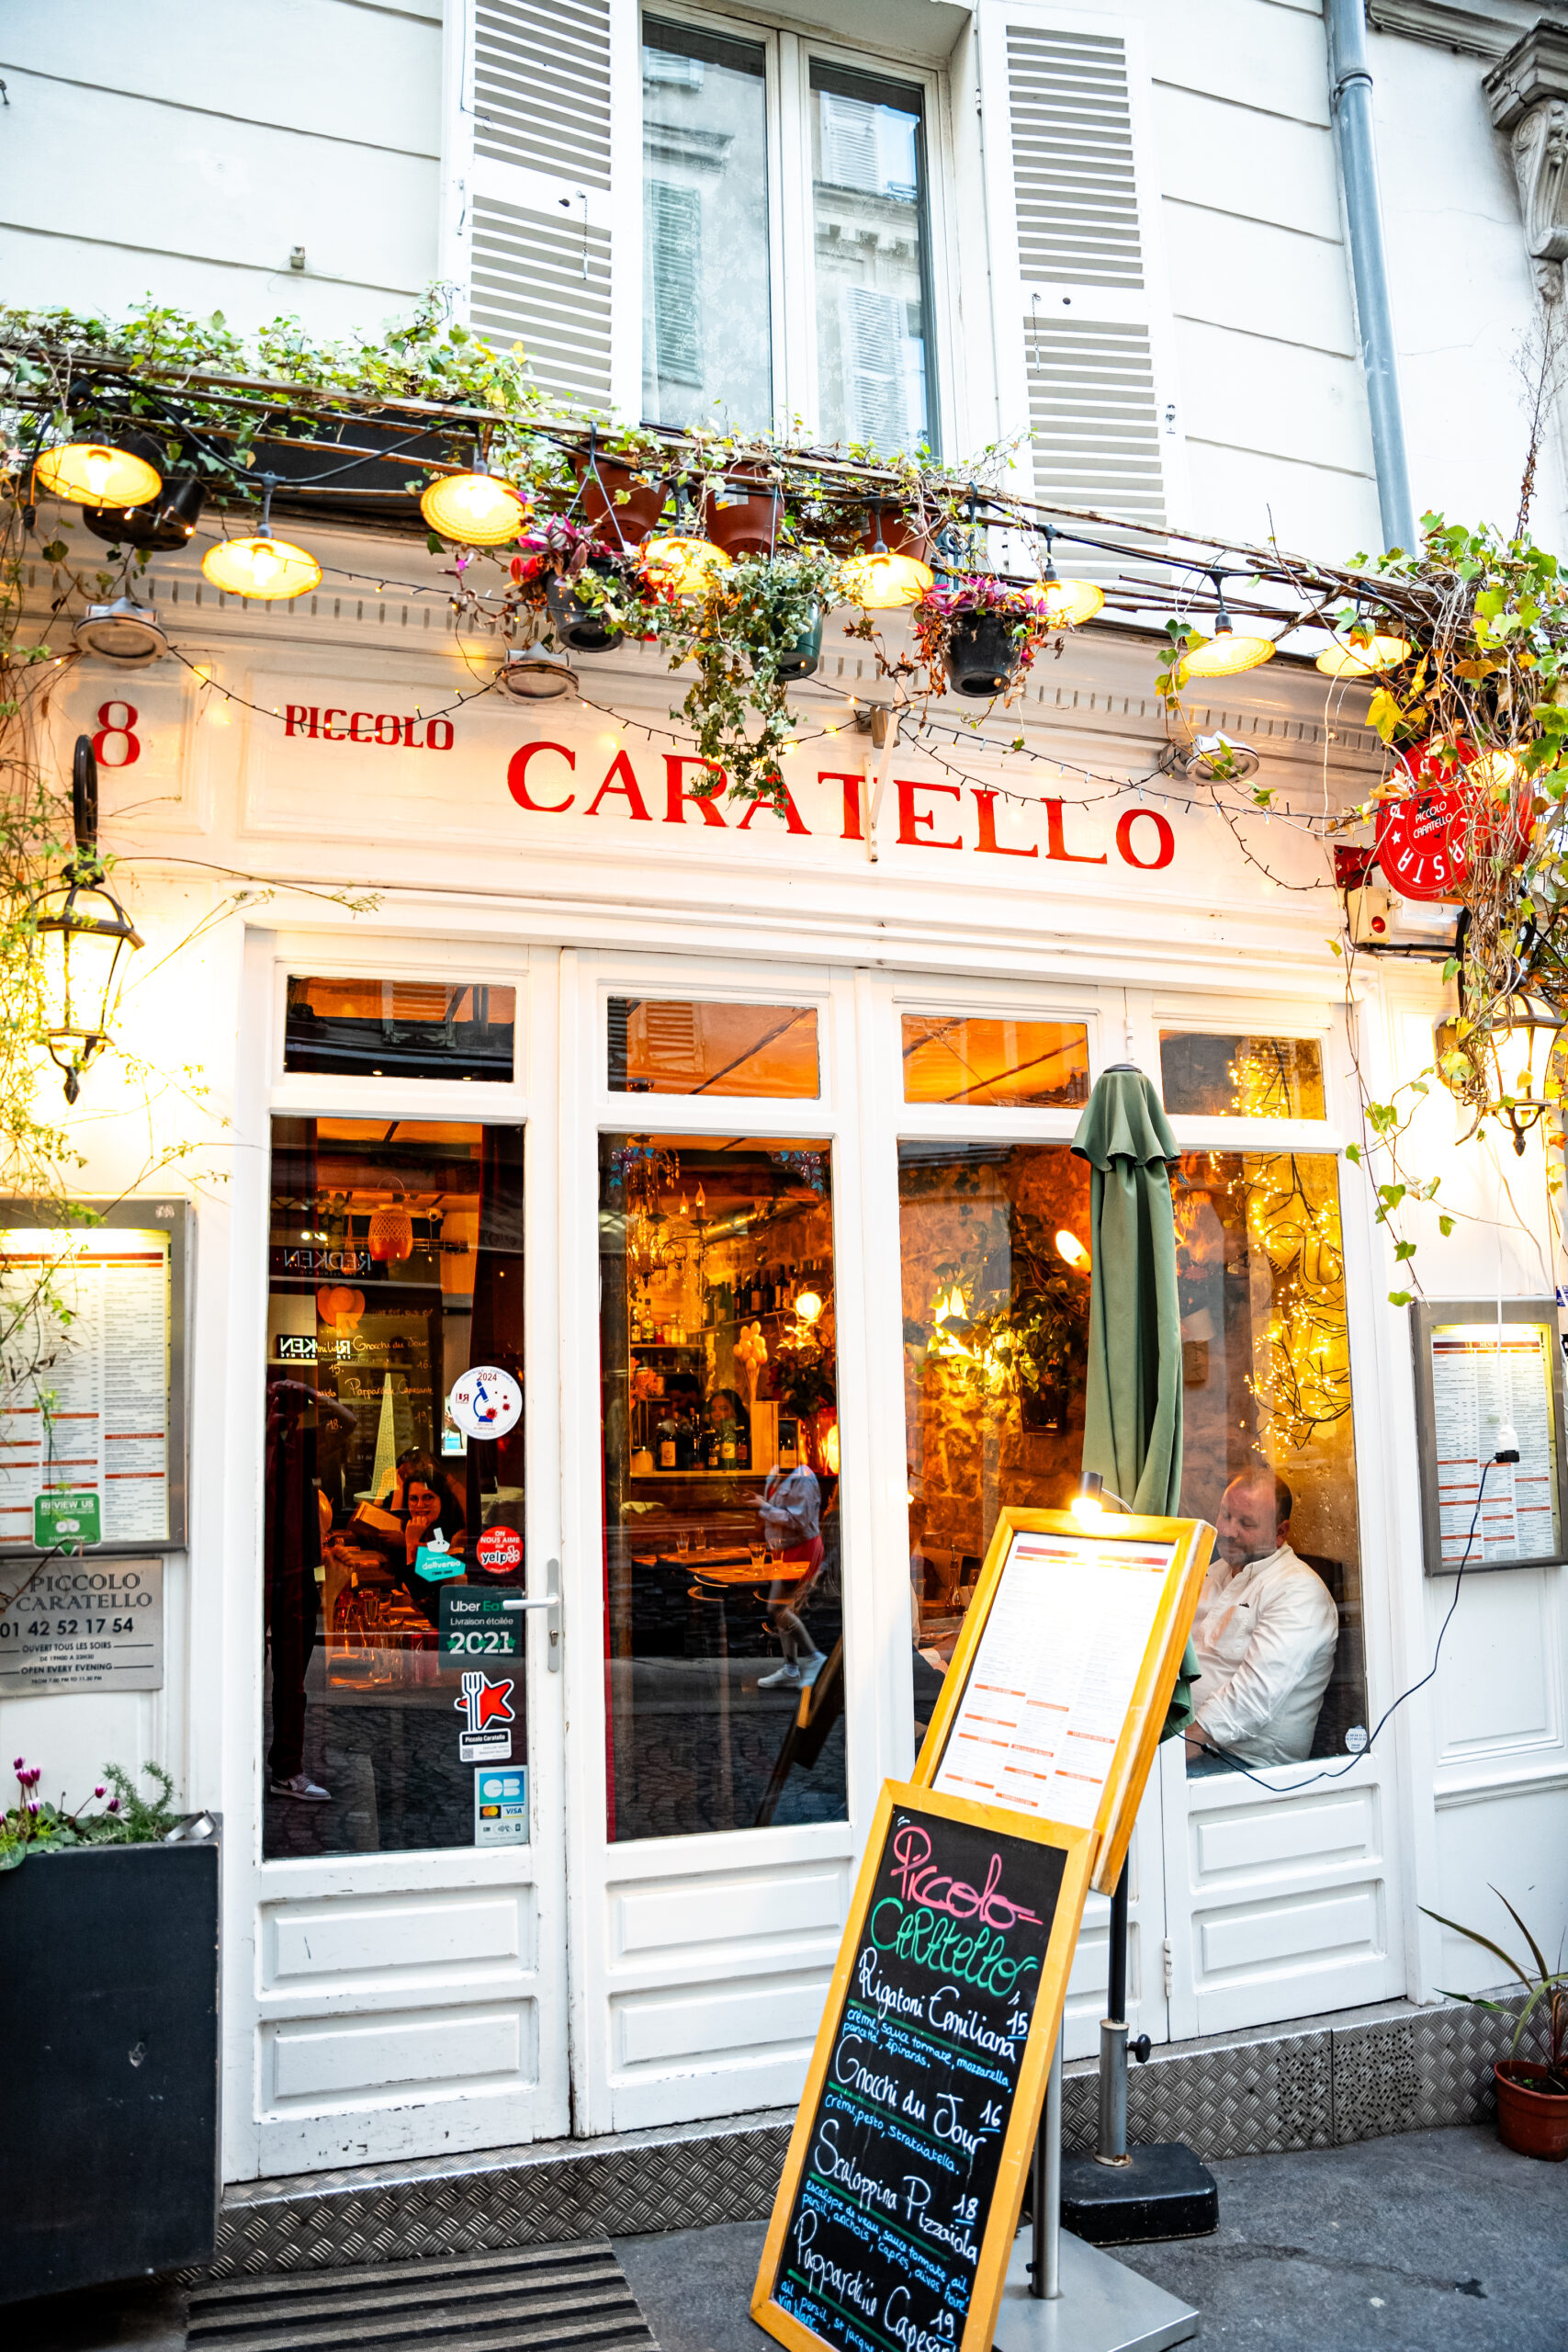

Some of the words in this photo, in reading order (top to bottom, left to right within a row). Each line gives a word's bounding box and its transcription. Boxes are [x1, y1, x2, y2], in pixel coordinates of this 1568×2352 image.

[93, 700, 141, 767] 8
[285, 704, 455, 751] PICCOLO
[507, 740, 1175, 870] CARATELLO
[1415, 800, 1447, 824] PICCOLO
[1413, 812, 1454, 839] CARATELLO
[479, 1372, 497, 1381] 2024
[481, 1551, 507, 1565] yelp
[29, 1572, 141, 1593] PICCOLO
[16, 1592, 152, 1611] CARATELLO
[450, 1600, 480, 1612] Uber
[0, 1622, 19, 1638] 01
[28, 1621, 50, 1635] 42
[57, 1619, 78, 1635] 52
[86, 1619, 106, 1634] 17
[112, 1617, 133, 1633] 54
[450, 1617, 485, 1625] Livraison
[486, 1617, 513, 1625] étoilée
[22, 1644, 52, 1653] OUVERT
[55, 1643, 73, 1651] TOUS
[76, 1642, 87, 1650] LES
[90, 1641, 111, 1649] SOIRS
[449, 1631, 514, 1654] 2021
[21, 1666, 44, 1675] OPEN
[47, 1665, 73, 1673] EVERY
[75, 1663, 112, 1671] EVENING
[464, 1735, 482, 1744] Piccolo
[858, 1946, 925, 2020] Rigatoni
[928, 1985, 1016, 2064] Emiliana
[1006, 2009, 1029, 2036] 15
[881, 2023, 909, 2044] sauce
[835, 2032, 898, 2108] Gnocchi
[901, 2089, 927, 2122] du
[932, 2092, 988, 2155] Jour
[978, 2098, 1004, 2128] 16
[814, 2119, 897, 2211] Scaloppina
[952, 2192, 980, 2220] 18
[806, 2179, 844, 2212] escalope
[883, 2229, 908, 2253] sauce
[929, 2308, 955, 2339] 19
